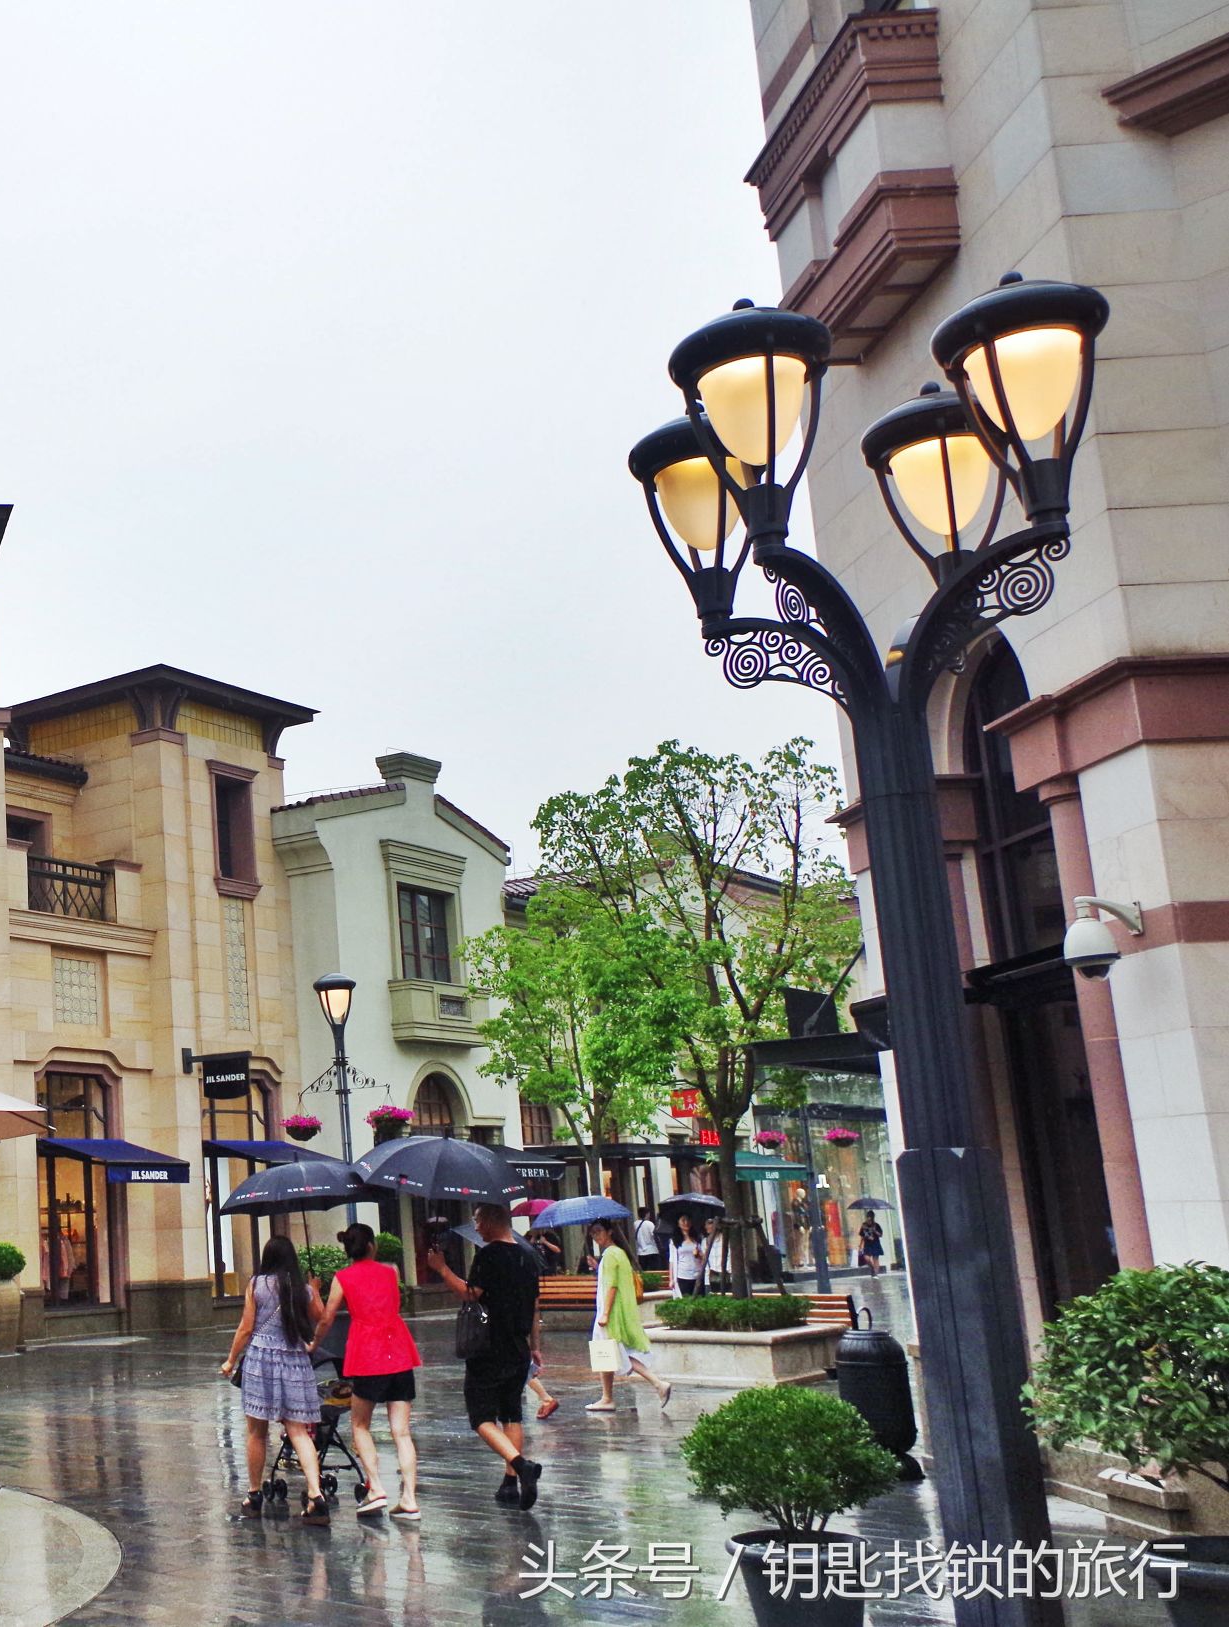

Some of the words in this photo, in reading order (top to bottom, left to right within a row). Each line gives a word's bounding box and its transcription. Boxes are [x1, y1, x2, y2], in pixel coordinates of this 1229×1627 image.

[206, 1075, 215, 1084] JIL
[215, 1073, 246, 1083] SANDER
[132, 1170, 140, 1180] JIL
[140, 1170, 169, 1180] SANDER
